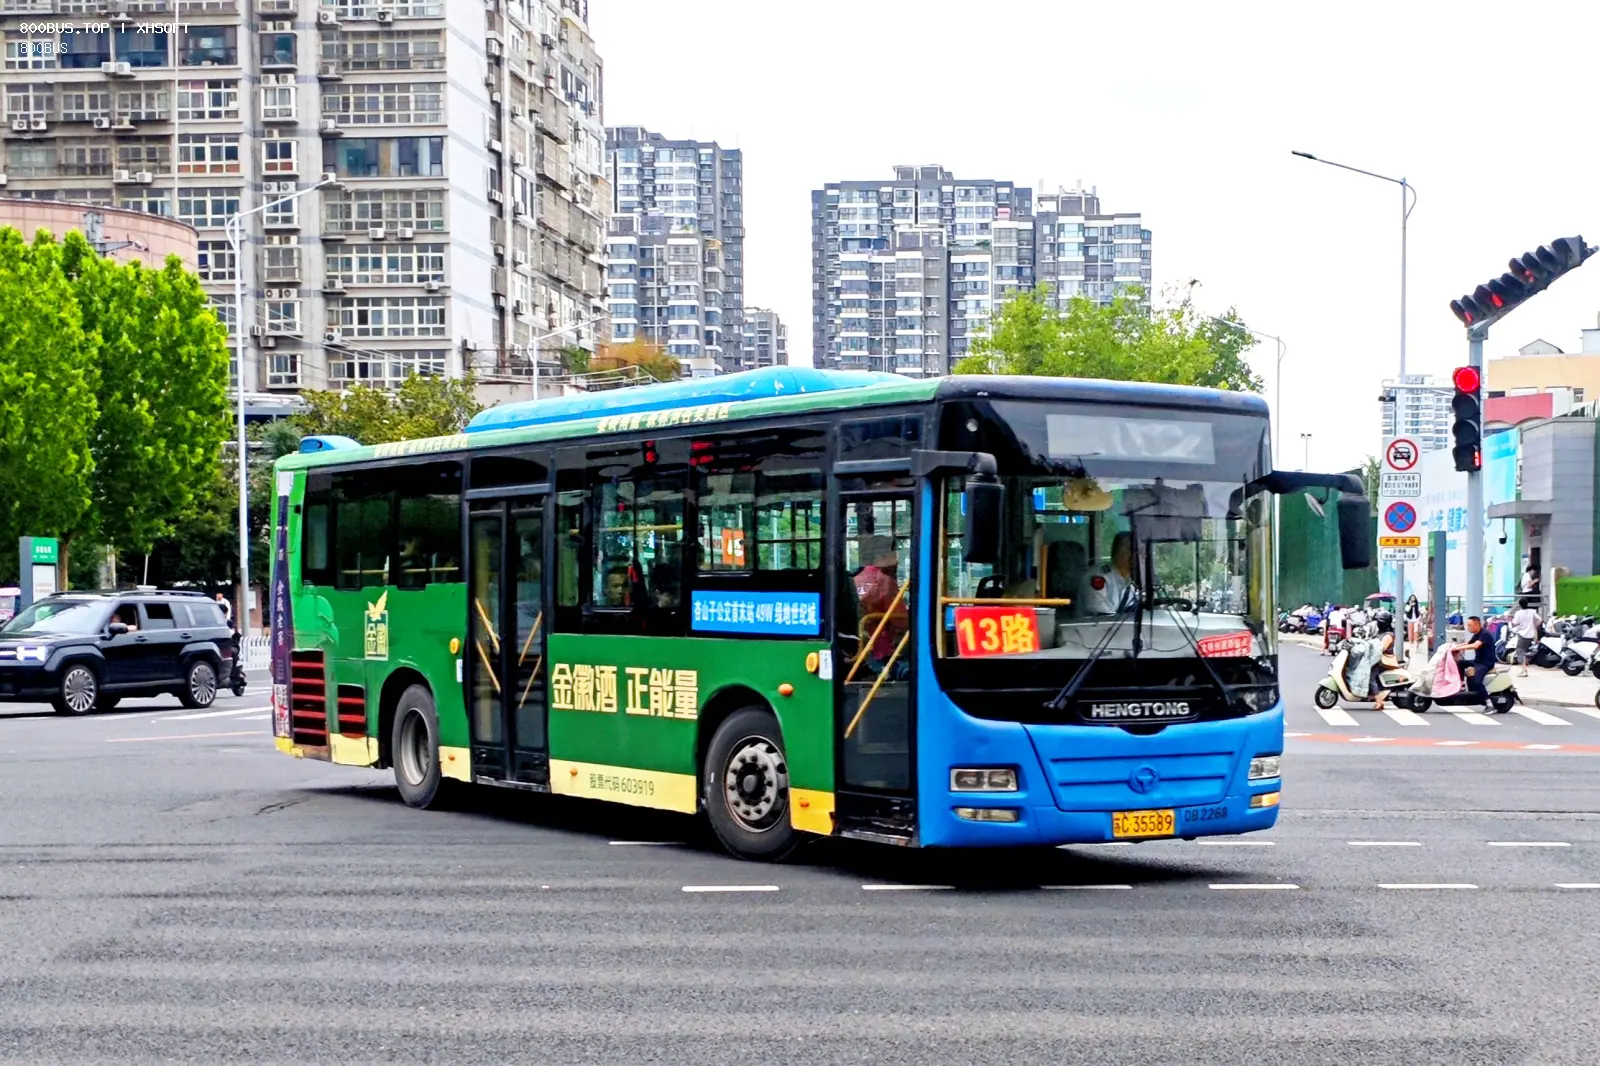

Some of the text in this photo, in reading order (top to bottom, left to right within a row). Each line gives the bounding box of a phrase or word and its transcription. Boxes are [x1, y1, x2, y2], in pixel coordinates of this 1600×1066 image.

[958, 613, 1034, 653] 13路
[551, 663, 698, 720] 金徽酒 正能量
[1091, 702, 1190, 718] HENGTONG
